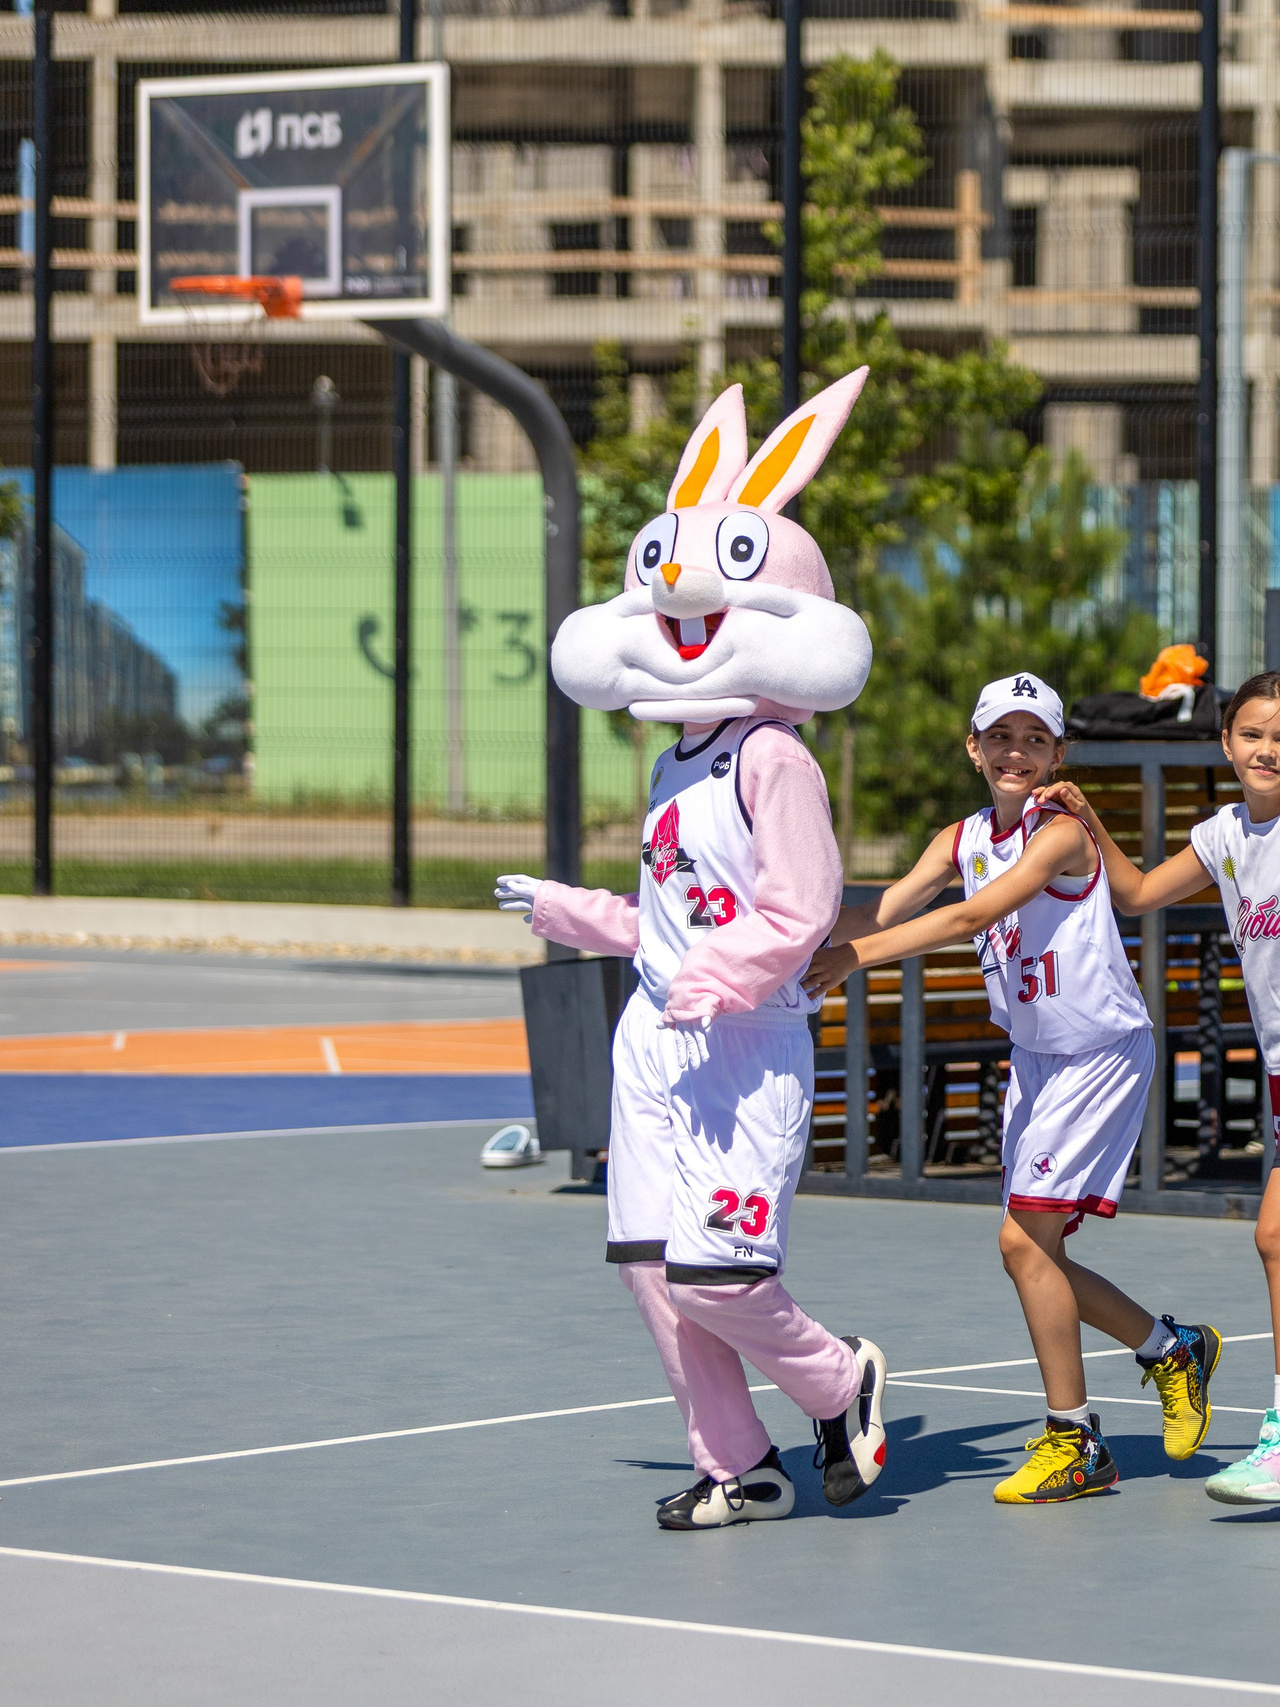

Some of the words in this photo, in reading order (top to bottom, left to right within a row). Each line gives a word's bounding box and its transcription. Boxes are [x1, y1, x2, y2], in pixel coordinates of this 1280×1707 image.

[278, 111, 342, 149] ПСБ
[1011, 676, 1038, 699] LA
[684, 884, 740, 929] 23
[1017, 950, 1060, 1005] 51
[703, 1186, 774, 1240] 23
[733, 1245, 754, 1258] FN
